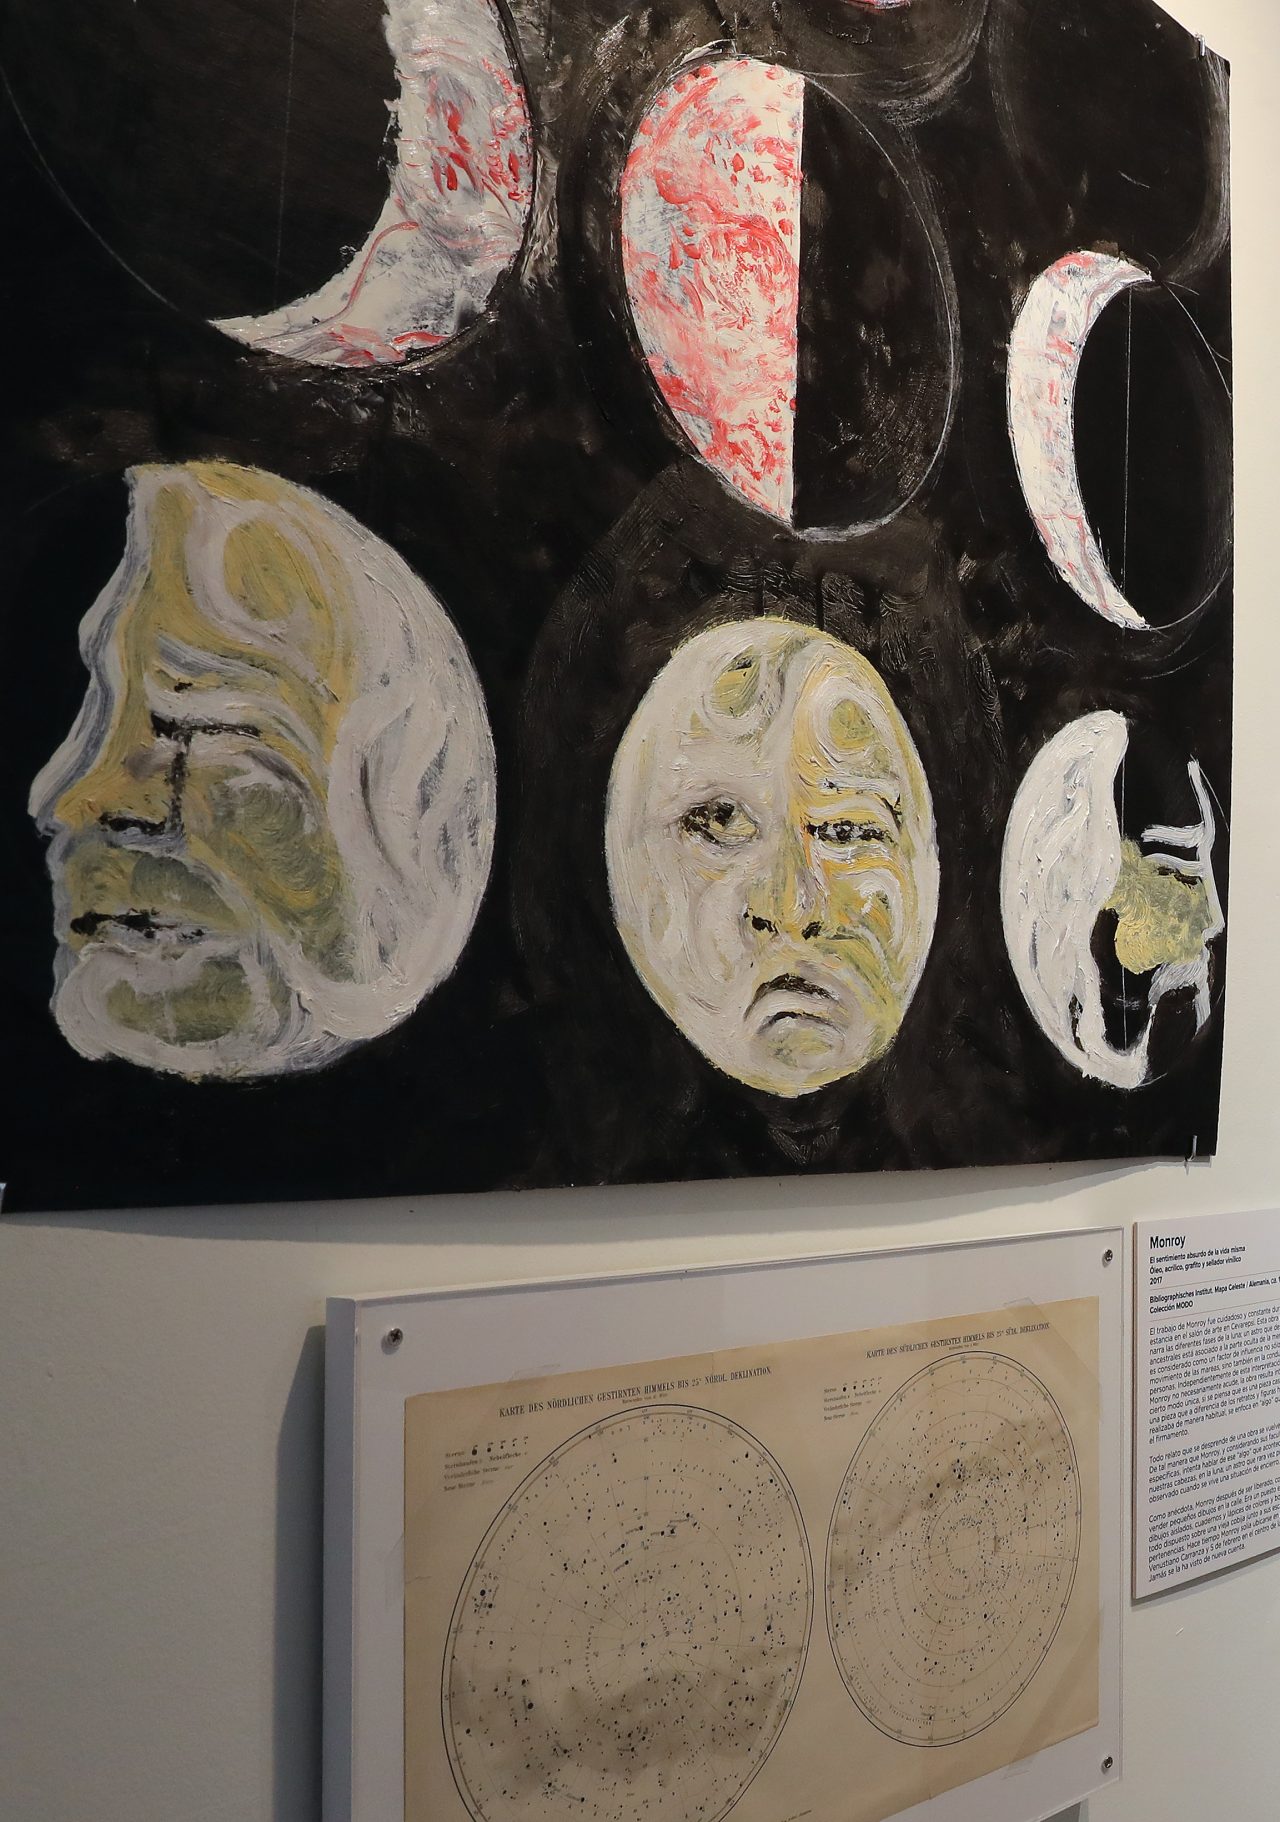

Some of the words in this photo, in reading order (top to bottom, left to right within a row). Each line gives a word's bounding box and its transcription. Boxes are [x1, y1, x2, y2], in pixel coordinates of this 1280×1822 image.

[1149, 1235, 1186, 1249] Monroy
[1155, 1253, 1186, 1263] sentimiento
[1186, 1250, 1207, 1259] absurdo
[1184, 1261, 1202, 1271] grafito
[1205, 1258, 1224, 1267] sellador
[1227, 1283, 1245, 1291] Celeste
[1149, 1304, 1175, 1314] Colección
[1175, 1300, 1193, 1310] MODO
[1156, 1324, 1177, 1334] trabajo
[1185, 1320, 1206, 1329] Monroy
[1216, 1313, 1243, 1323] cuidadoso
[1247, 1308, 1271, 1318] constante
[1149, 1334, 1173, 1345] estancia
[1188, 1329, 1203, 1338] salón
[499, 1405, 525, 1418] KARTE
[528, 1402, 544, 1413] DES
[547, 1393, 594, 1410] NÖRDLICHEN
[597, 1386, 641, 1402] GESTIRNTEN
[644, 1382, 675, 1394] HIMMELS
[677, 1379, 689, 1389] BIS
